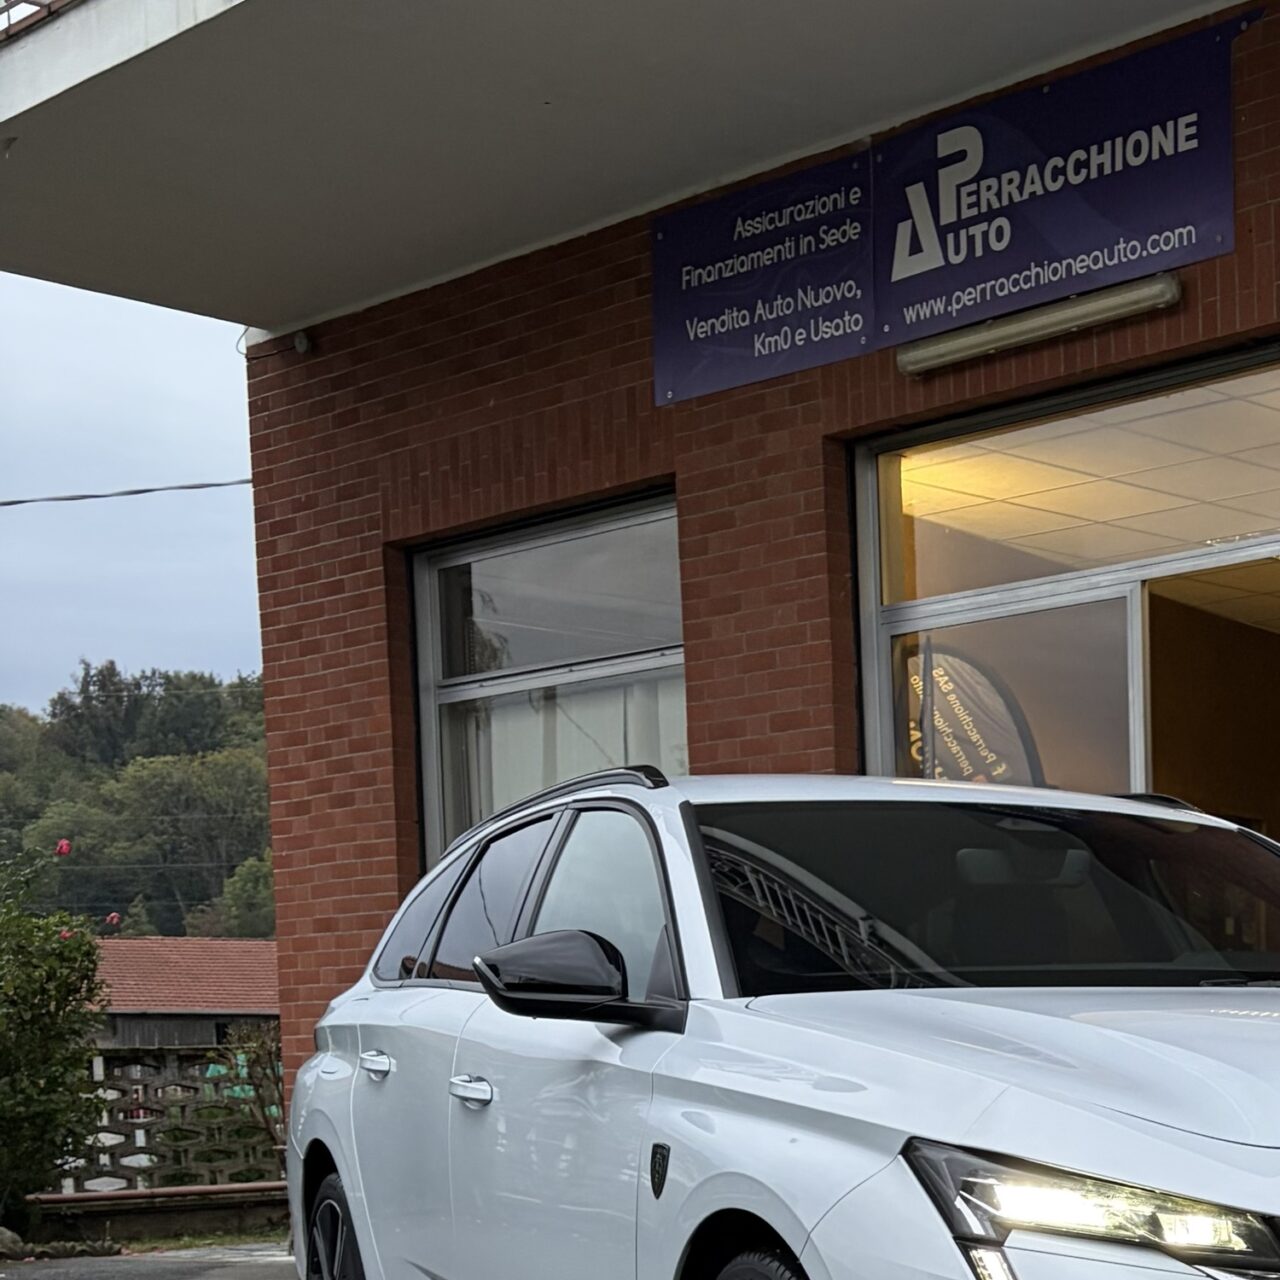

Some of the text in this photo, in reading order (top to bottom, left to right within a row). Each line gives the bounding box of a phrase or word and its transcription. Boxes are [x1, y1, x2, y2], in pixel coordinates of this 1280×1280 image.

[936, 112, 1199, 226] PERRACCHIONE
[733, 187, 862, 241] Assicurazioni e
[890, 181, 1012, 283] AUTO
[681, 219, 862, 290] Finanziamenti in Sede
[903, 221, 1196, 325] www.perracchioneauto.com
[686, 278, 863, 342] Vendita Auto Nuovo,
[794, 329, 806, 348] e
[810, 312, 864, 343] Usato
